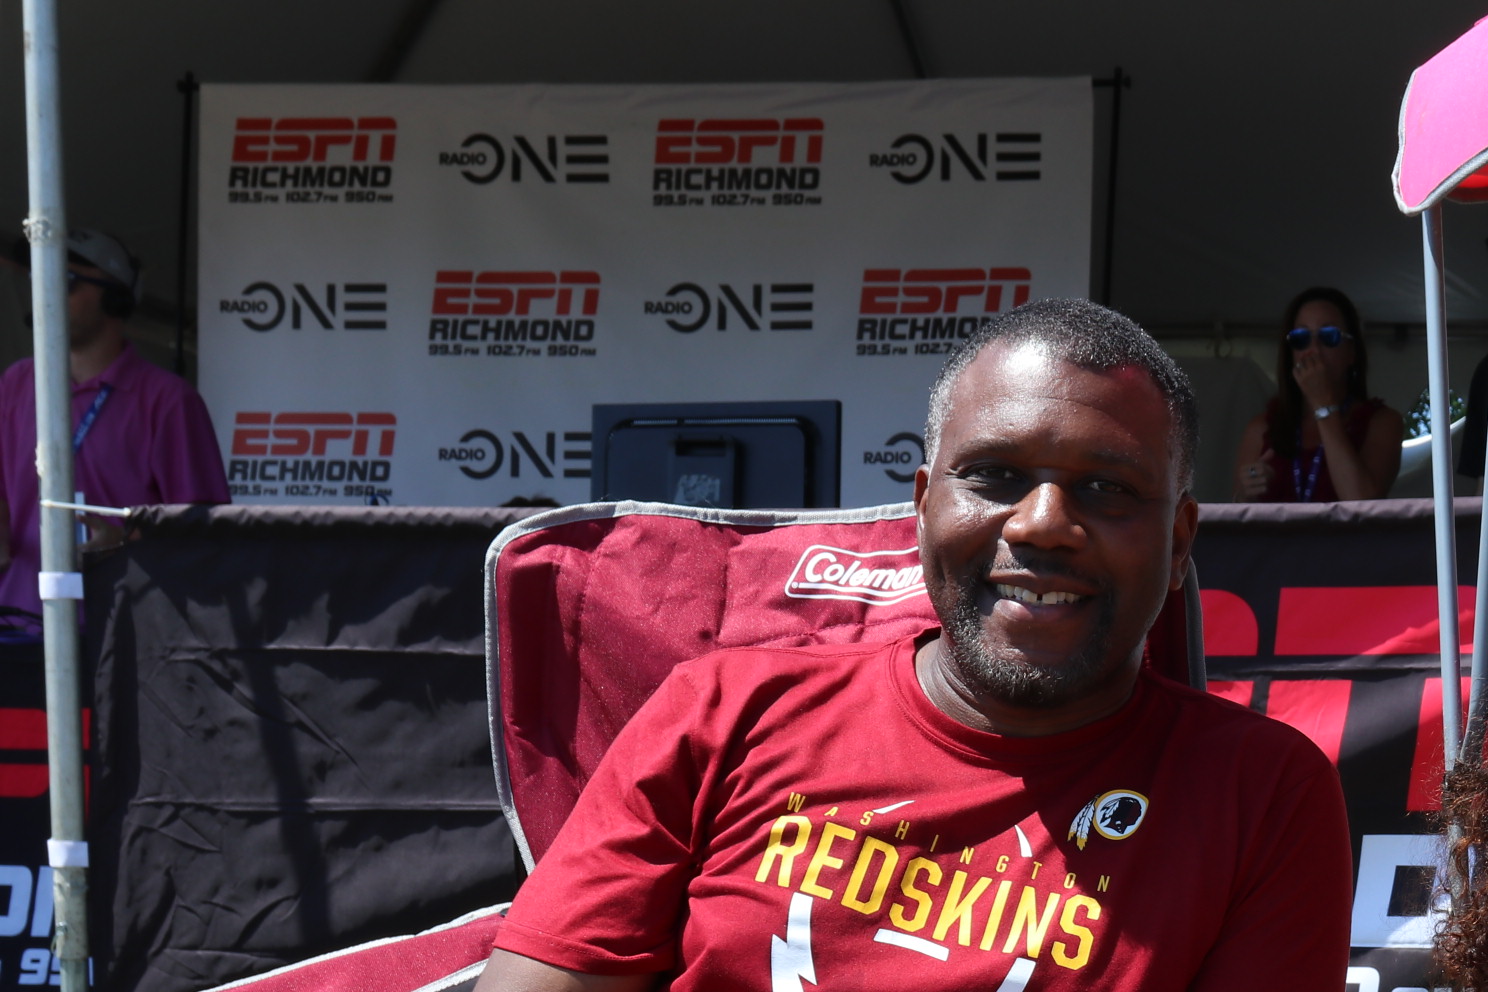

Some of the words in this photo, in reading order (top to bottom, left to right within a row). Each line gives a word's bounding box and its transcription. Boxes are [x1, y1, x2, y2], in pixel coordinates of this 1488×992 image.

[232, 116, 397, 162] ESPN
[439, 152, 486, 165] RADIO
[460, 132, 610, 184] ONE
[655, 117, 824, 164] ESPN
[889, 133, 1041, 184] ONE
[229, 165, 392, 188] RICHMOND
[653, 166, 820, 191] RICHMOND
[870, 153, 917, 167] RADIO
[220, 301, 267, 314] RADIO
[241, 281, 387, 332] ONE
[432, 270, 601, 315] ESPN
[644, 301, 693, 315] RADIO
[665, 282, 814, 333] ONE
[860, 267, 1031, 314] ESPN
[428, 319, 595, 342] RICHMOND
[857, 317, 993, 340] RICHMO
[231, 412, 397, 456] ESPN
[439, 448, 485, 461] RADIO
[458, 429, 593, 479] ONE
[228, 459, 391, 481] RICHMOND
[863, 451, 912, 464] RADIO
[805, 551, 923, 589] Coleman
[787, 792, 1112, 893] WASHINGTON
[754, 815, 1103, 971] REDSKINS
